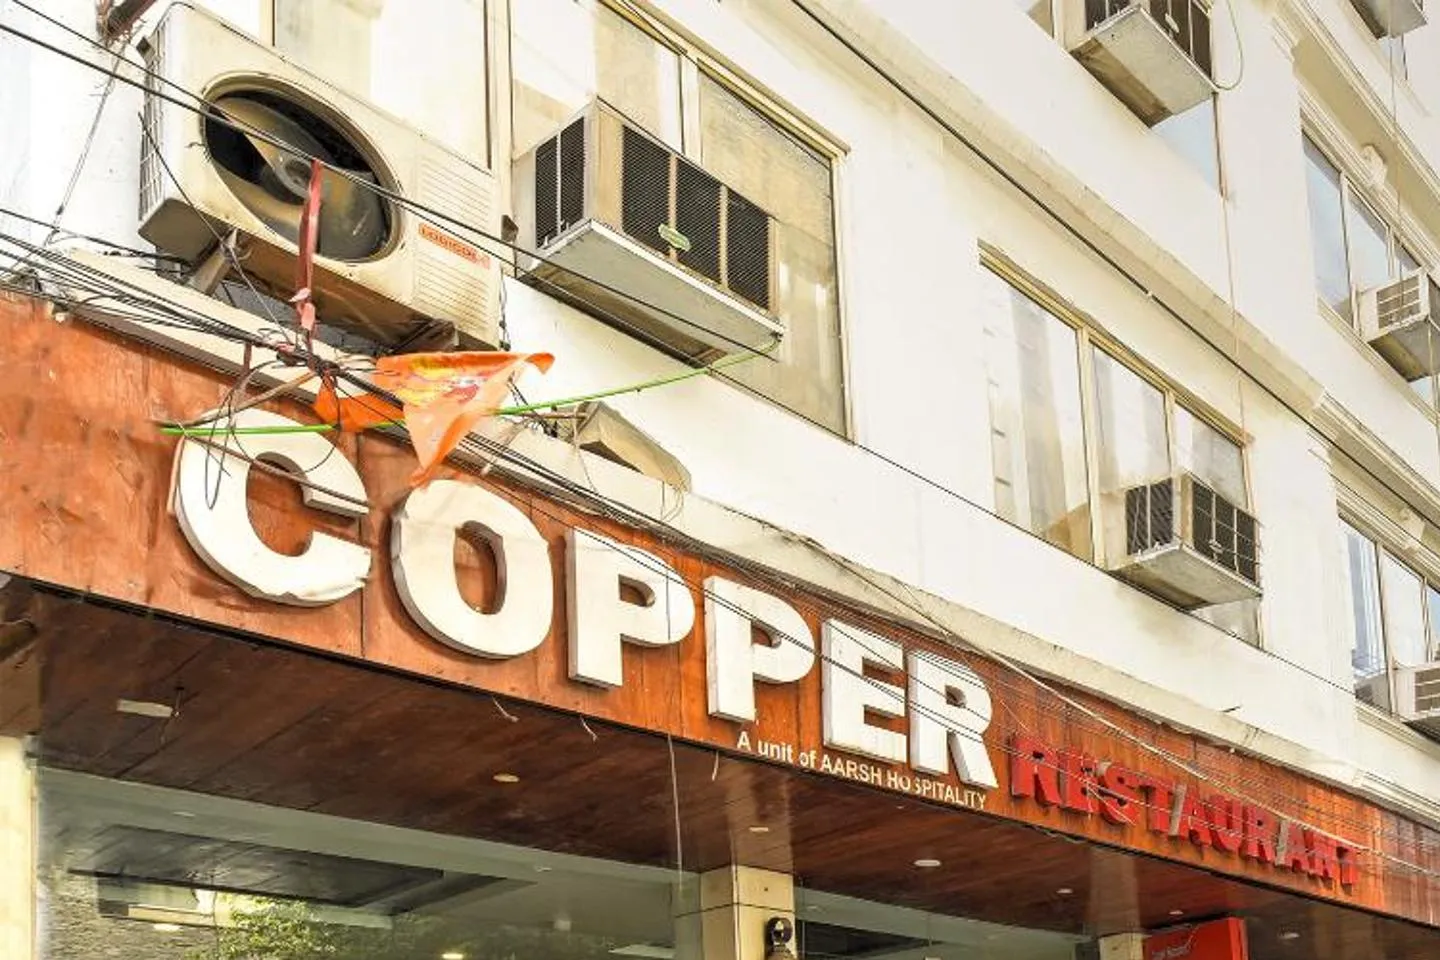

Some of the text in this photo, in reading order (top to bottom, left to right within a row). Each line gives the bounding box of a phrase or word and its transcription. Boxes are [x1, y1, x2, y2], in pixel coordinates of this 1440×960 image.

[169, 406, 998, 790] COPPER
[737, 731, 988, 811] A unit of AARSH HOSPITALITY
